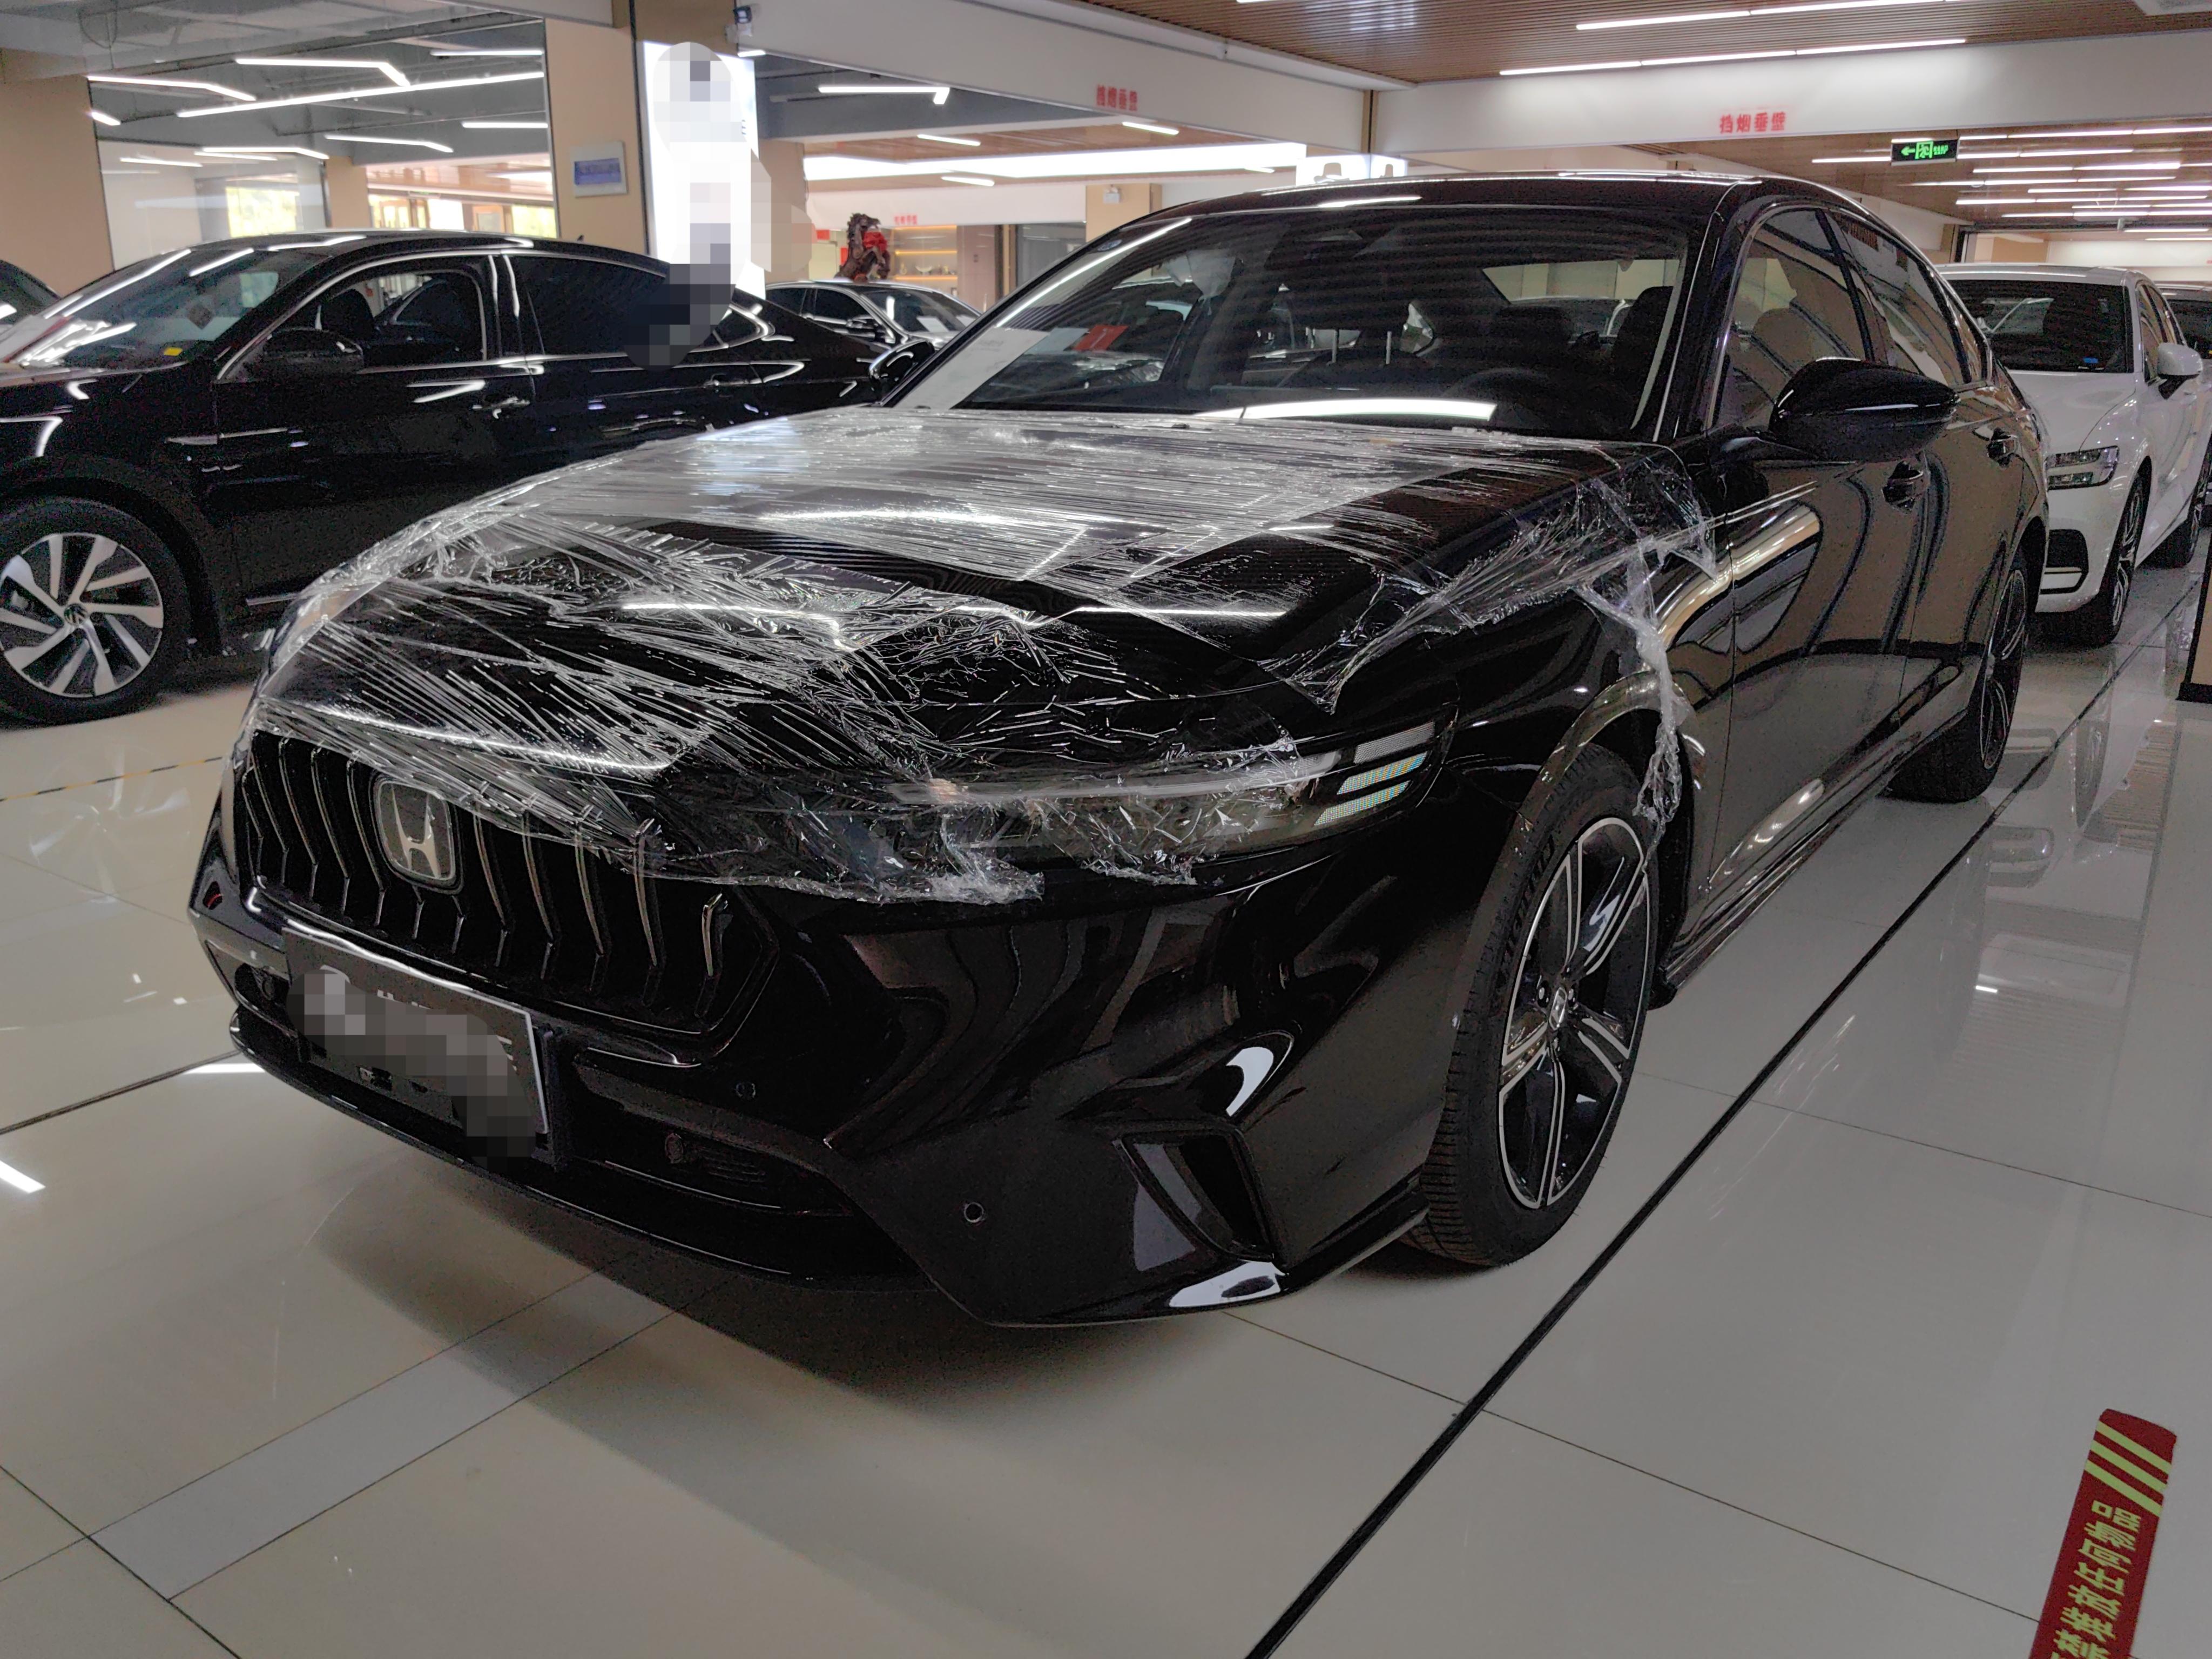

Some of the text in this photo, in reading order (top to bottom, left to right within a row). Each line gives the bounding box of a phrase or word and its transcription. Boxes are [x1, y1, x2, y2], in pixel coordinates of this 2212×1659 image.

[1719, 112, 1786, 133] 挡烟垂壁
[2049, 1500, 2142, 1659] 禁堆放任何物品
